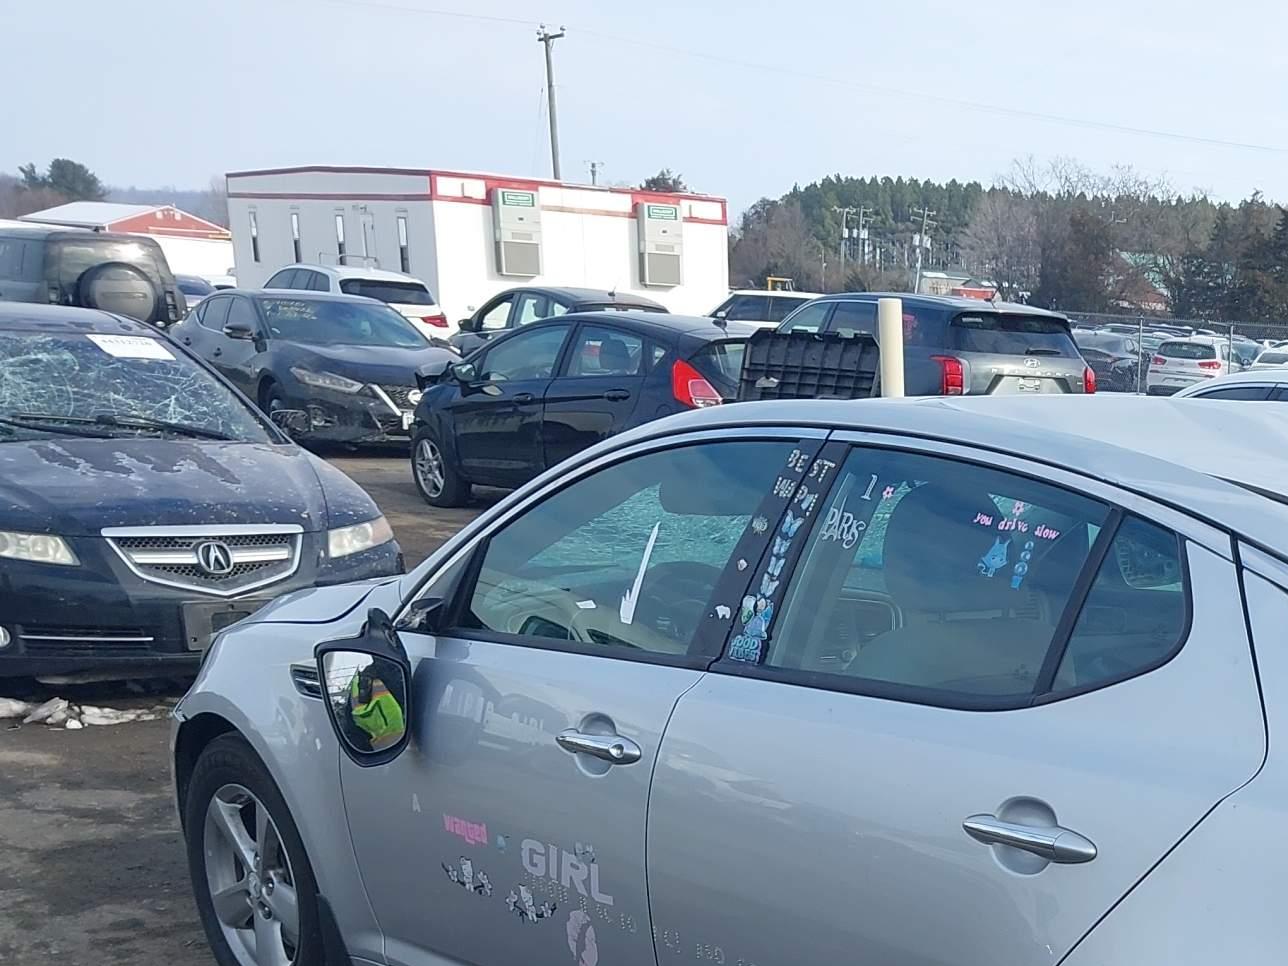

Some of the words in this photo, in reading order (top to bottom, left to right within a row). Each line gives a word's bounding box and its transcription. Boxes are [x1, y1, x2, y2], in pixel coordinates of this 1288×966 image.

[973, 512, 993, 526] you
[998, 518, 1029, 533] drive
[1034, 523, 1060, 540] slow
[520, 838, 614, 906] GIRL
